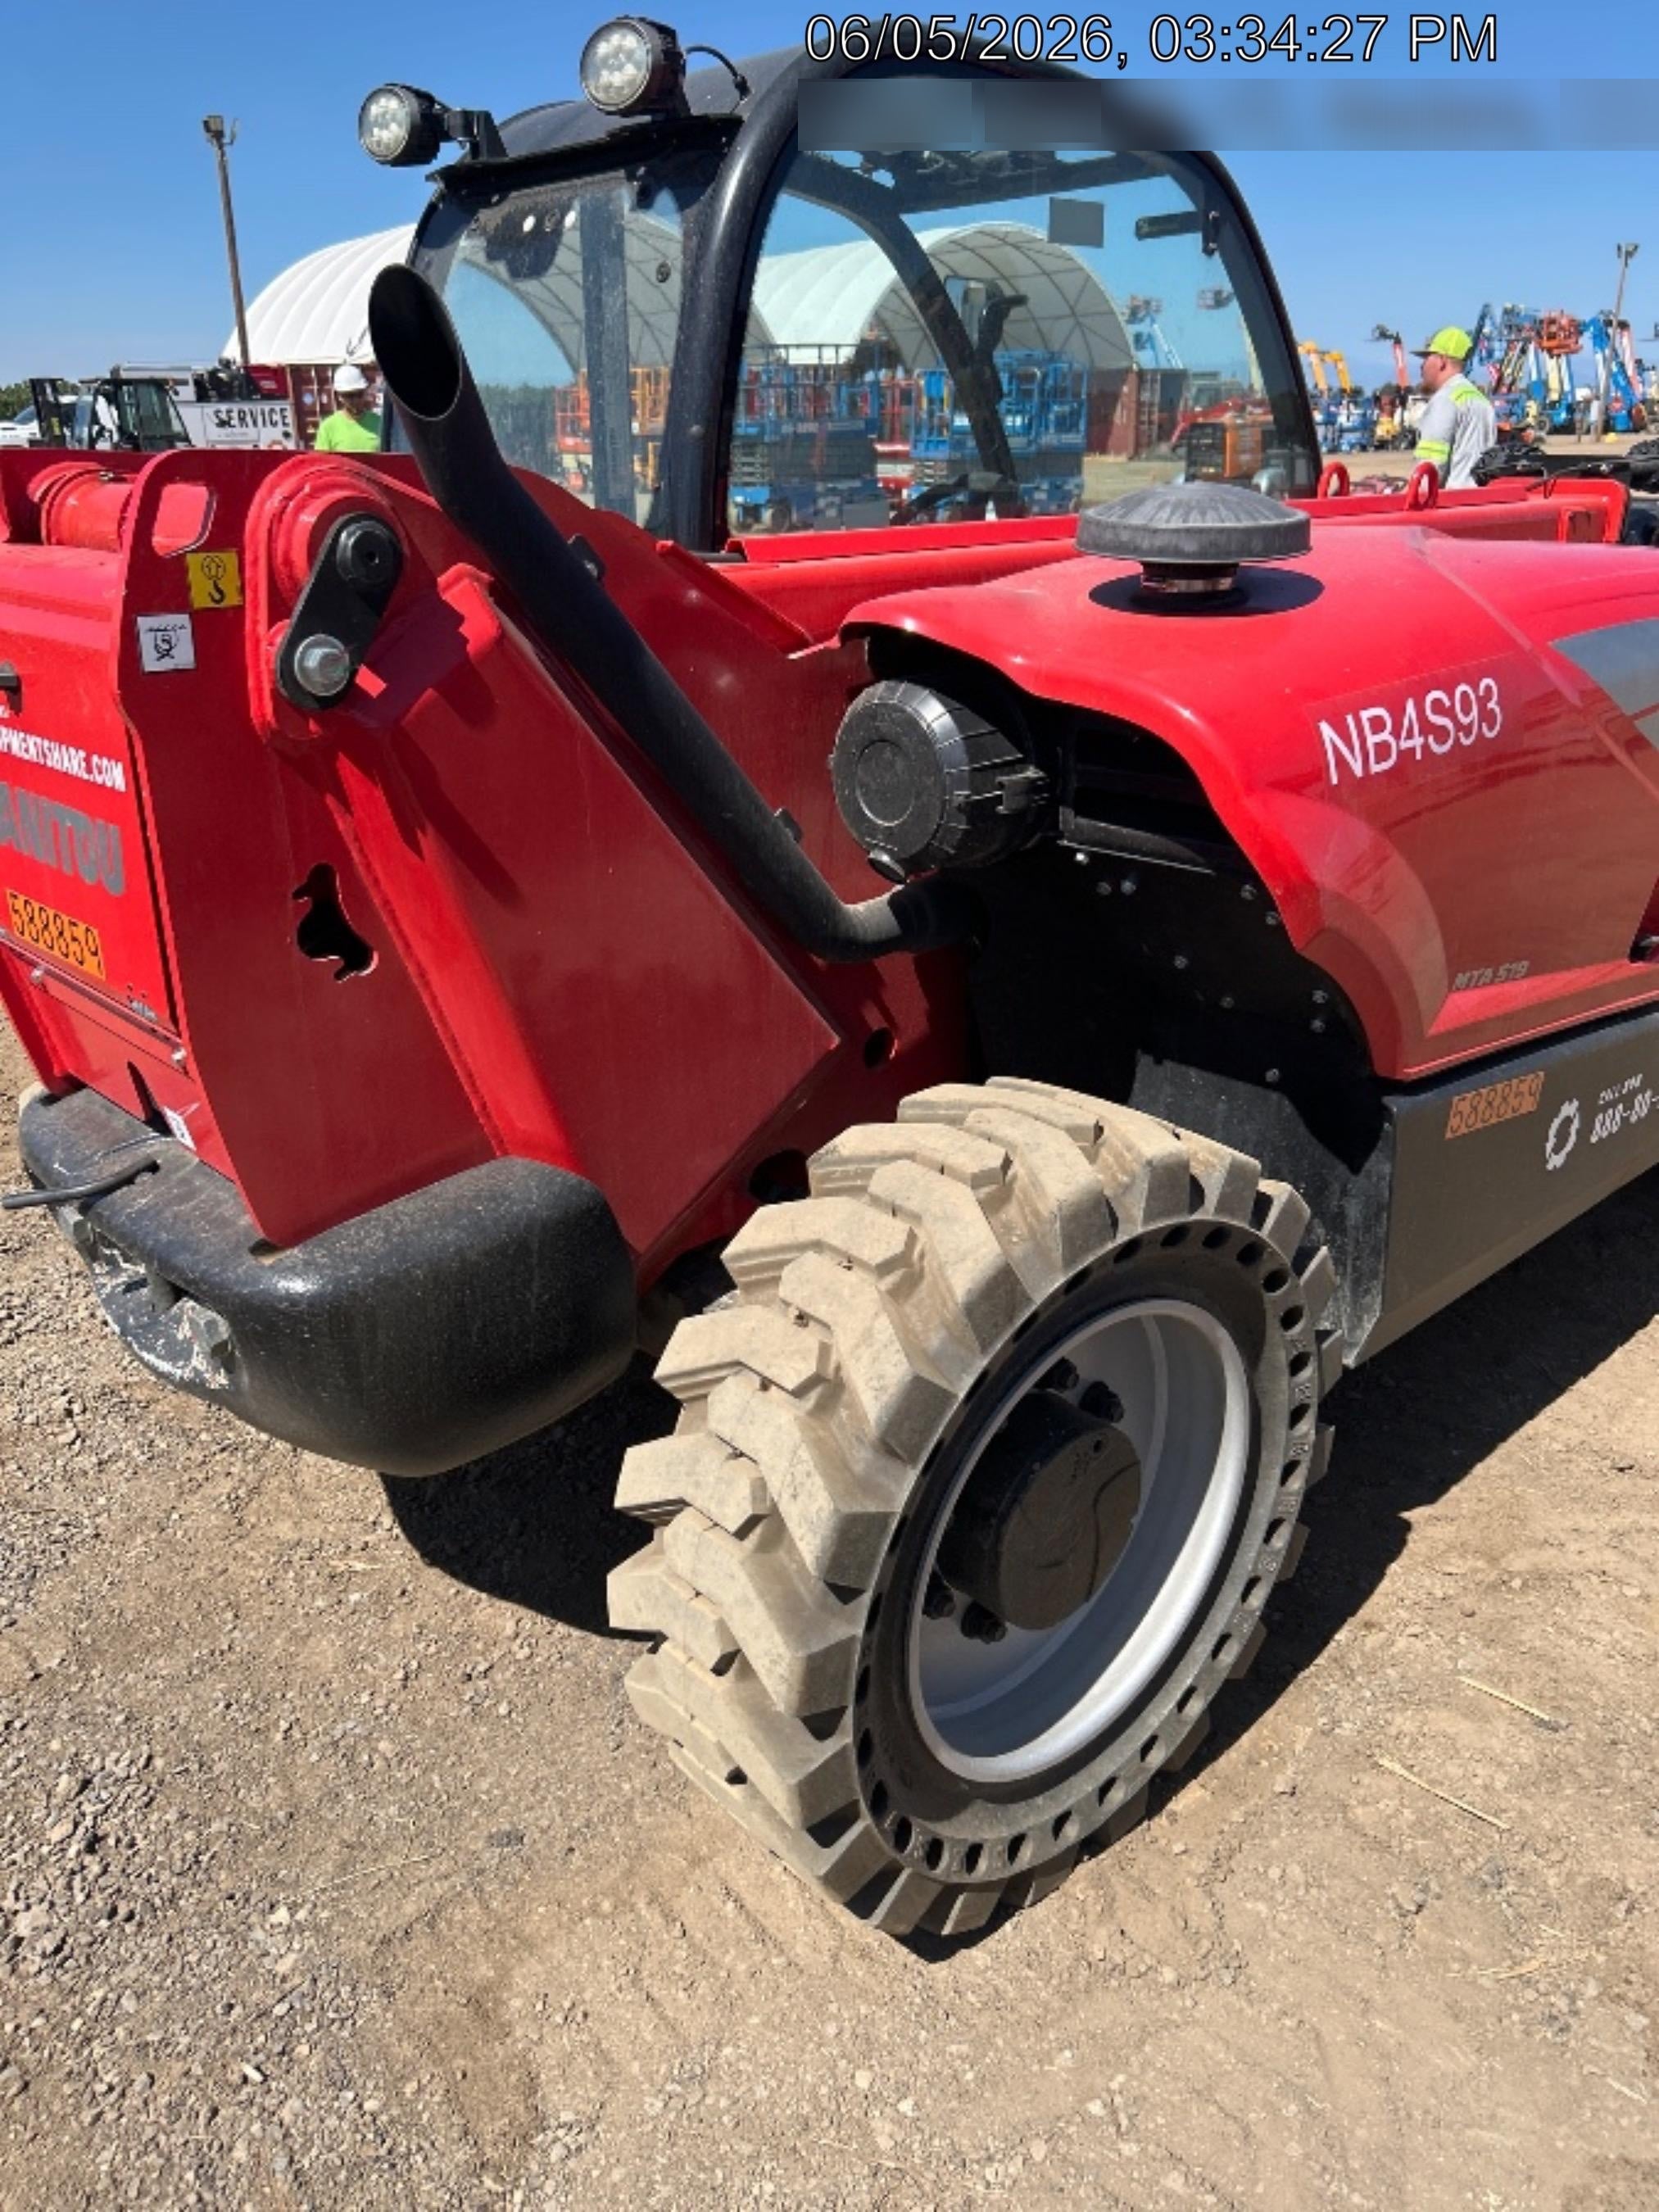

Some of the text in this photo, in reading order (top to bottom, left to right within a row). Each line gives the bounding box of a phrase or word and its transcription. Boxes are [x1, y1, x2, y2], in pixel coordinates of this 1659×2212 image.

[213, 407, 290, 428] SERVICE
[0, 723, 126, 793] PMENTSHARE.COM
[1318, 678, 1503, 786] NB4S93
[9, 891, 104, 972] 588859
[1448, 1072, 1544, 1135] 588859
